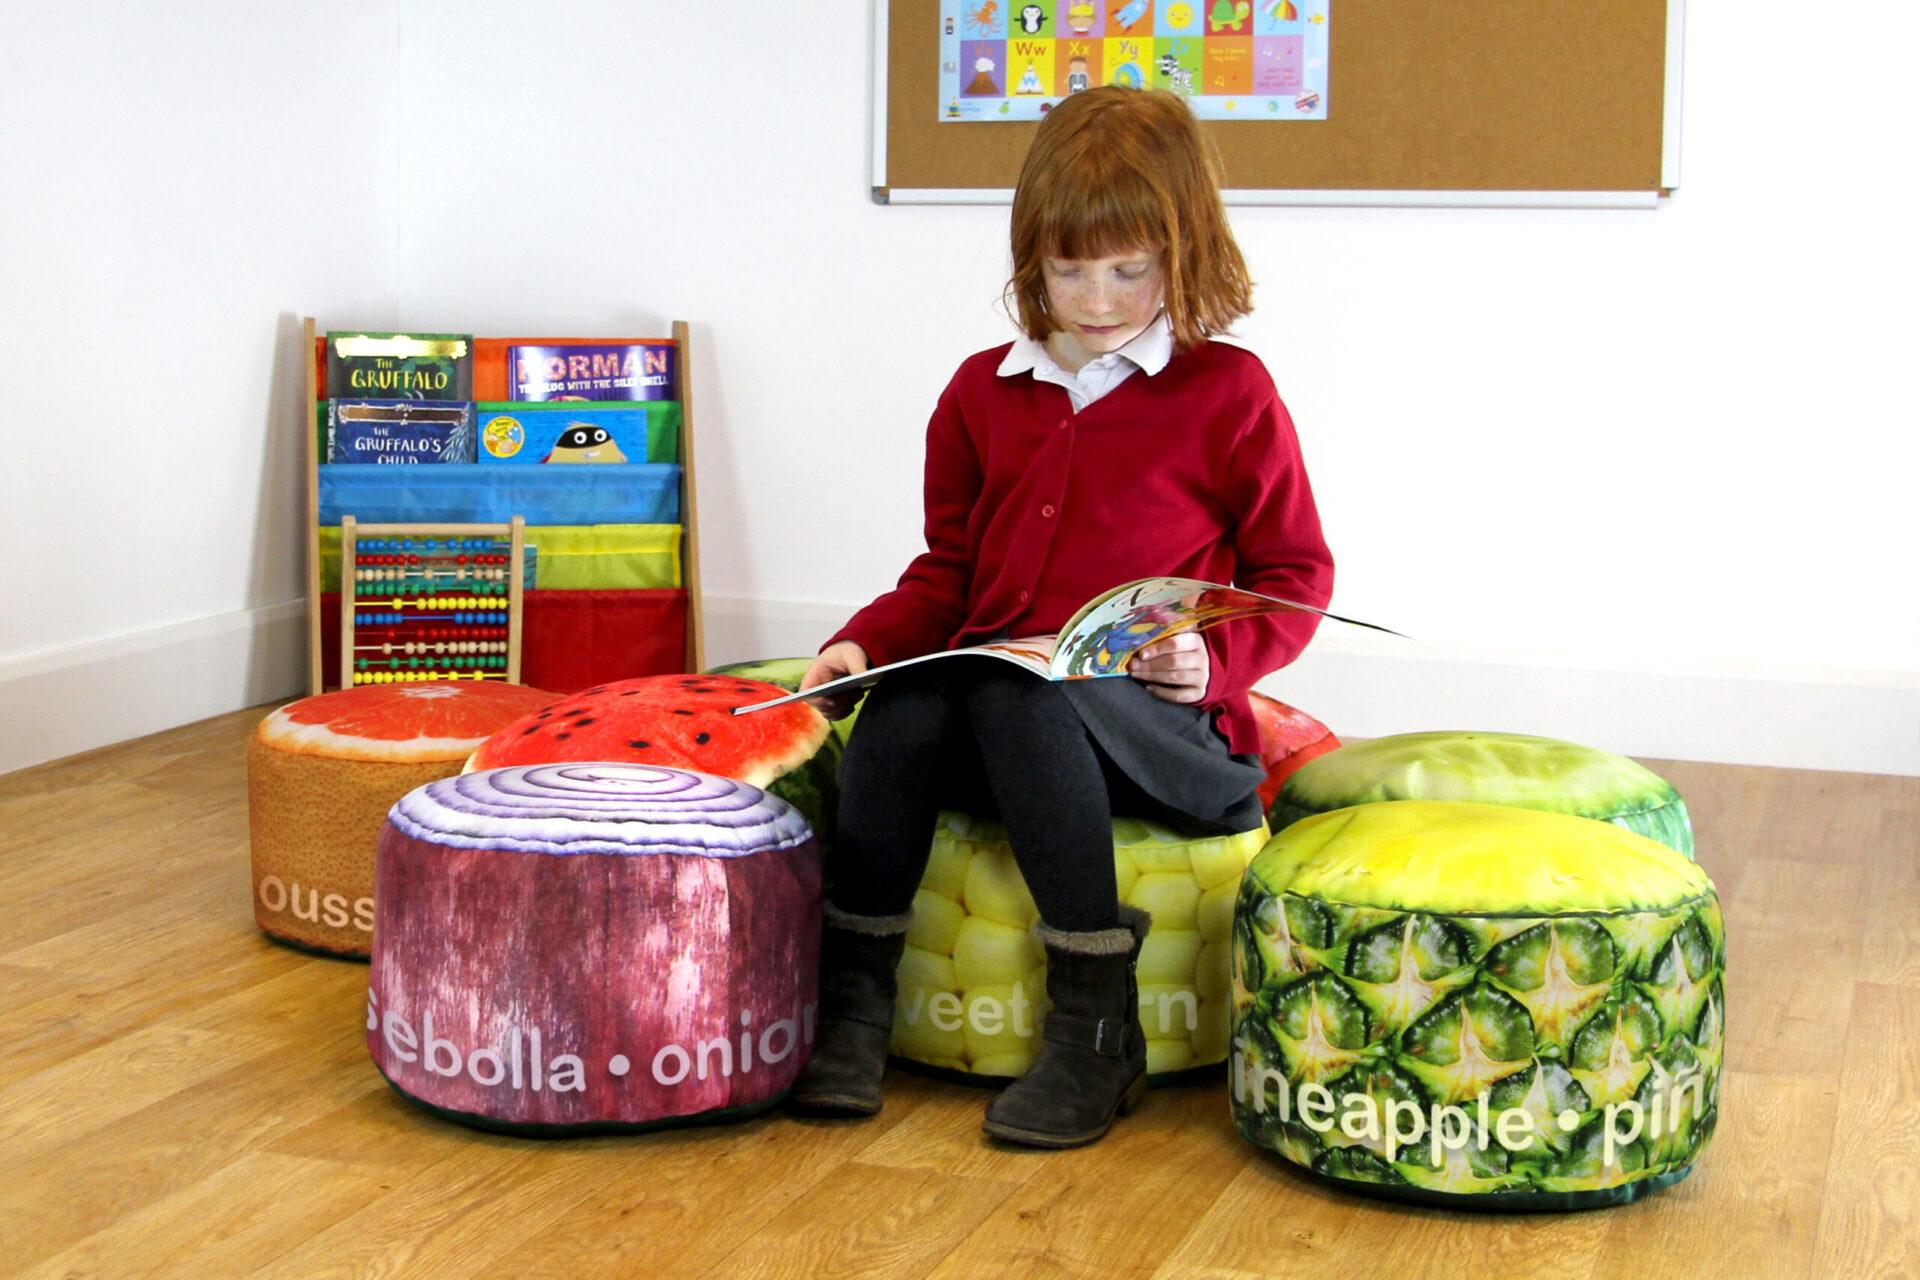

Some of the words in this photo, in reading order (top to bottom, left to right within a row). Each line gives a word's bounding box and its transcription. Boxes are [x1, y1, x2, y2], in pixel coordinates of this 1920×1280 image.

[1016, 42, 1046, 56] Ww
[1069, 41, 1091, 56] Xx
[1119, 40, 1139, 60] Yy
[376, 358, 394, 369] THE
[350, 369, 448, 391] GRUFFALO
[567, 380, 591, 391] WITH
[593, 379, 611, 390] THE
[373, 427, 390, 436] THE
[354, 437, 442, 453] GRUFFALO'S
